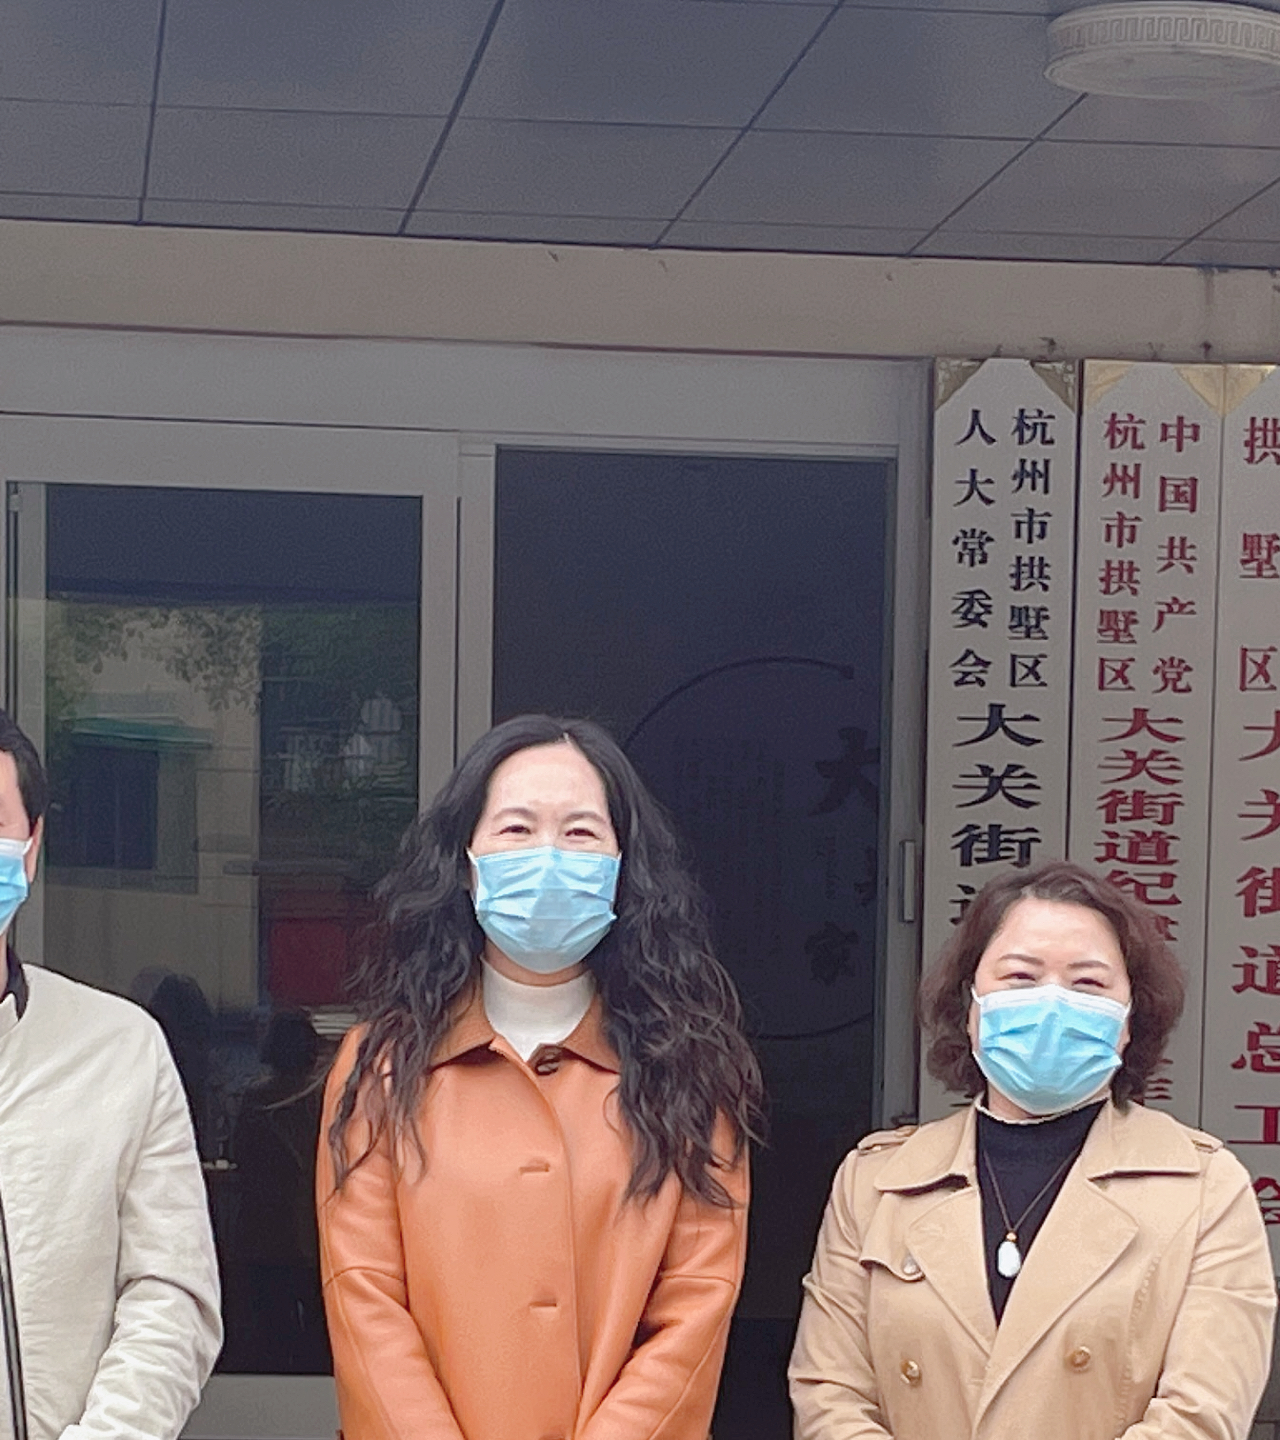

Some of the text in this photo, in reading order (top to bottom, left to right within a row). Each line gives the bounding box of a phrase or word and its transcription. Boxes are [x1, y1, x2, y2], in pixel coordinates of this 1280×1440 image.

[949, 409, 996, 688] 人大常委会
[1007, 408, 1055, 688] 杭州市拱墅区
[1097, 412, 1146, 692] 杭州市拱墅区
[1152, 416, 1200, 695] 中国共产党
